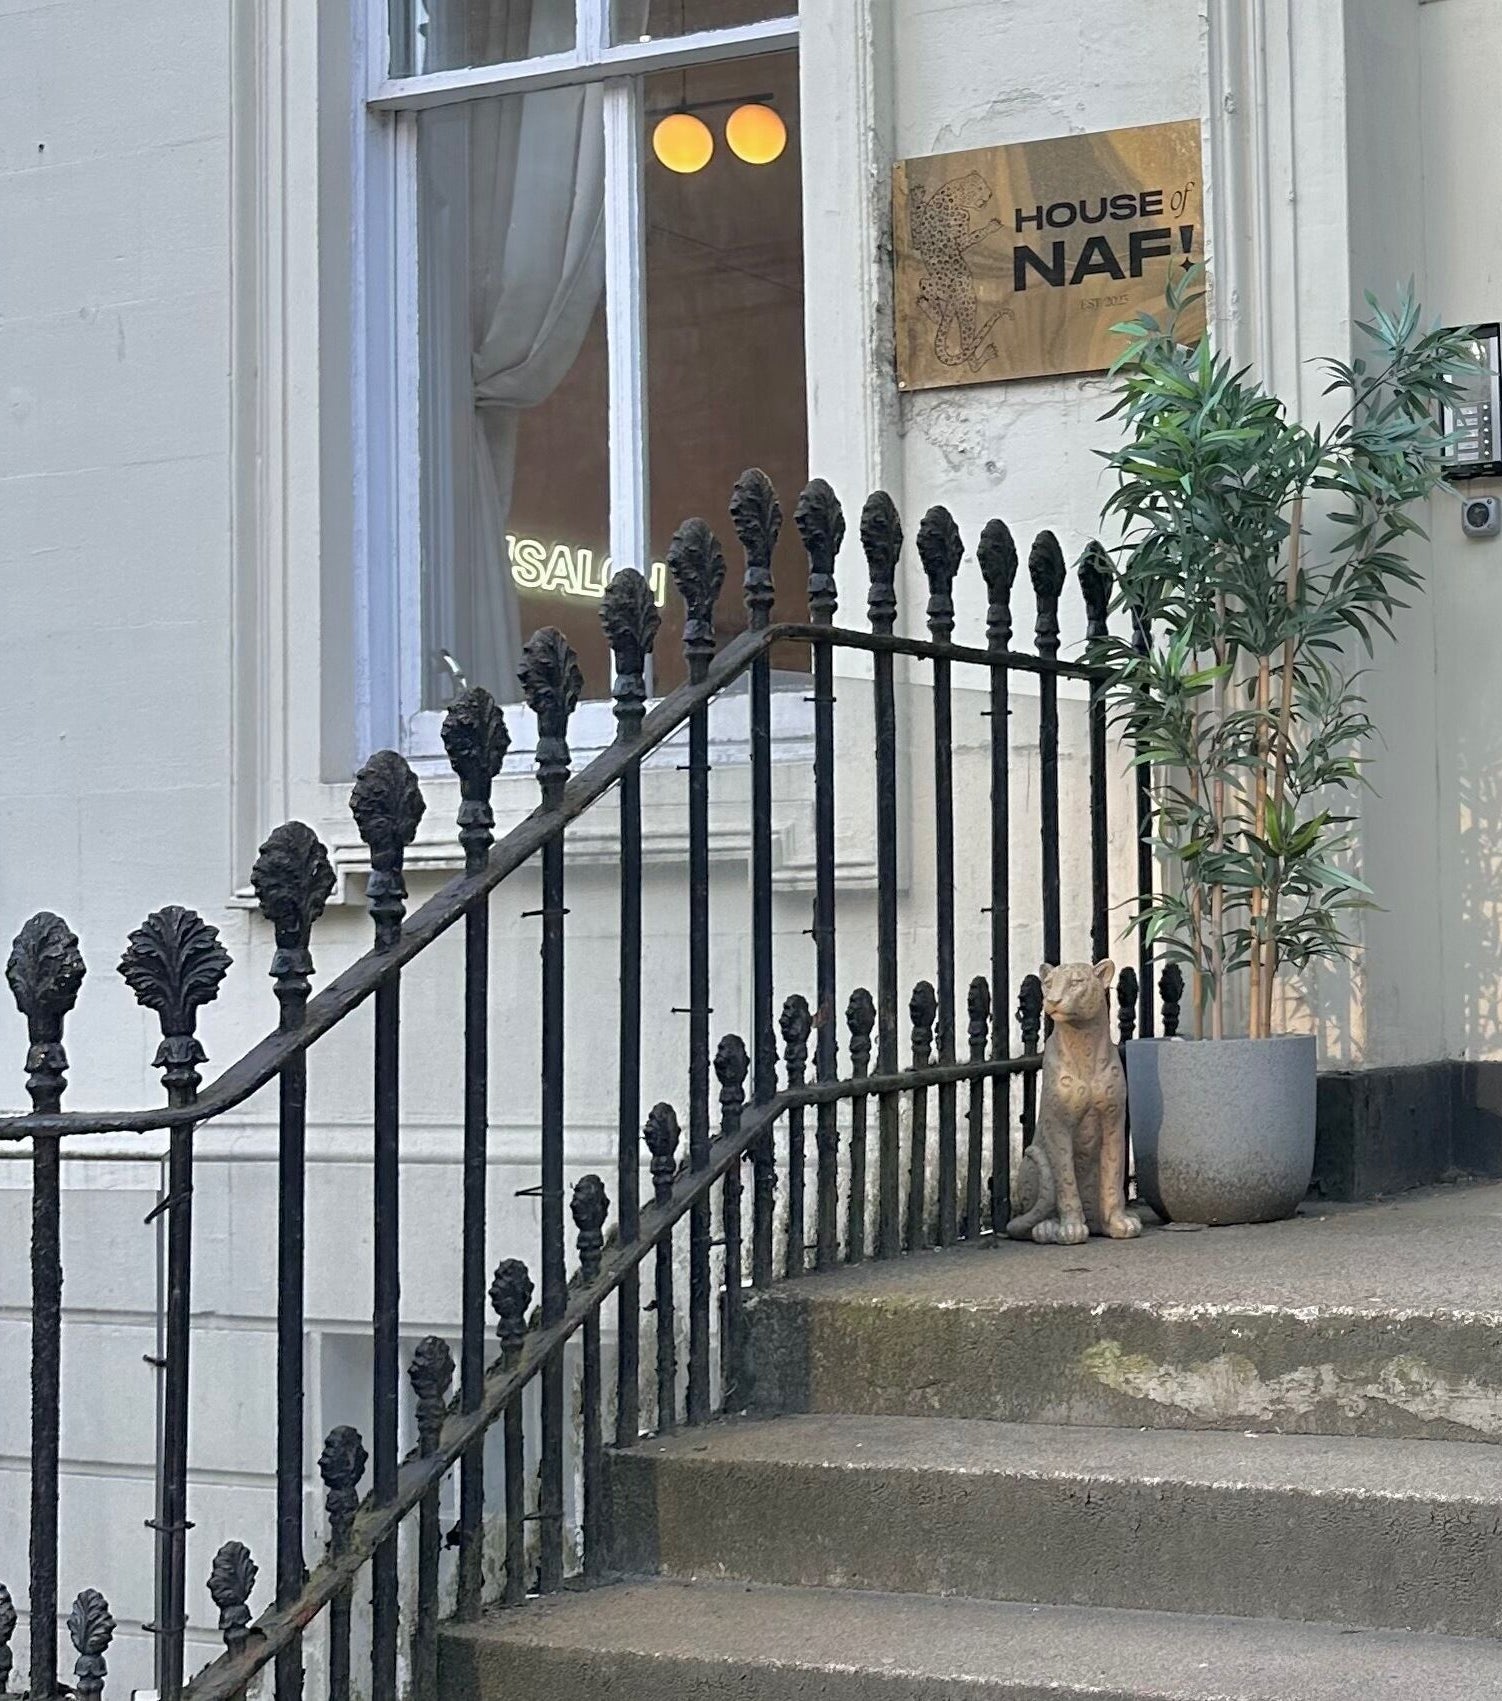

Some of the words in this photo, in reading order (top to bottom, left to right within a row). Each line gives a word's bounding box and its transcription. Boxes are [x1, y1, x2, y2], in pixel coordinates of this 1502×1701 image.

[1015, 189, 1164, 233] HOUSE
[1170, 181, 1195, 219] of
[1013, 224, 1196, 292] NAF!
